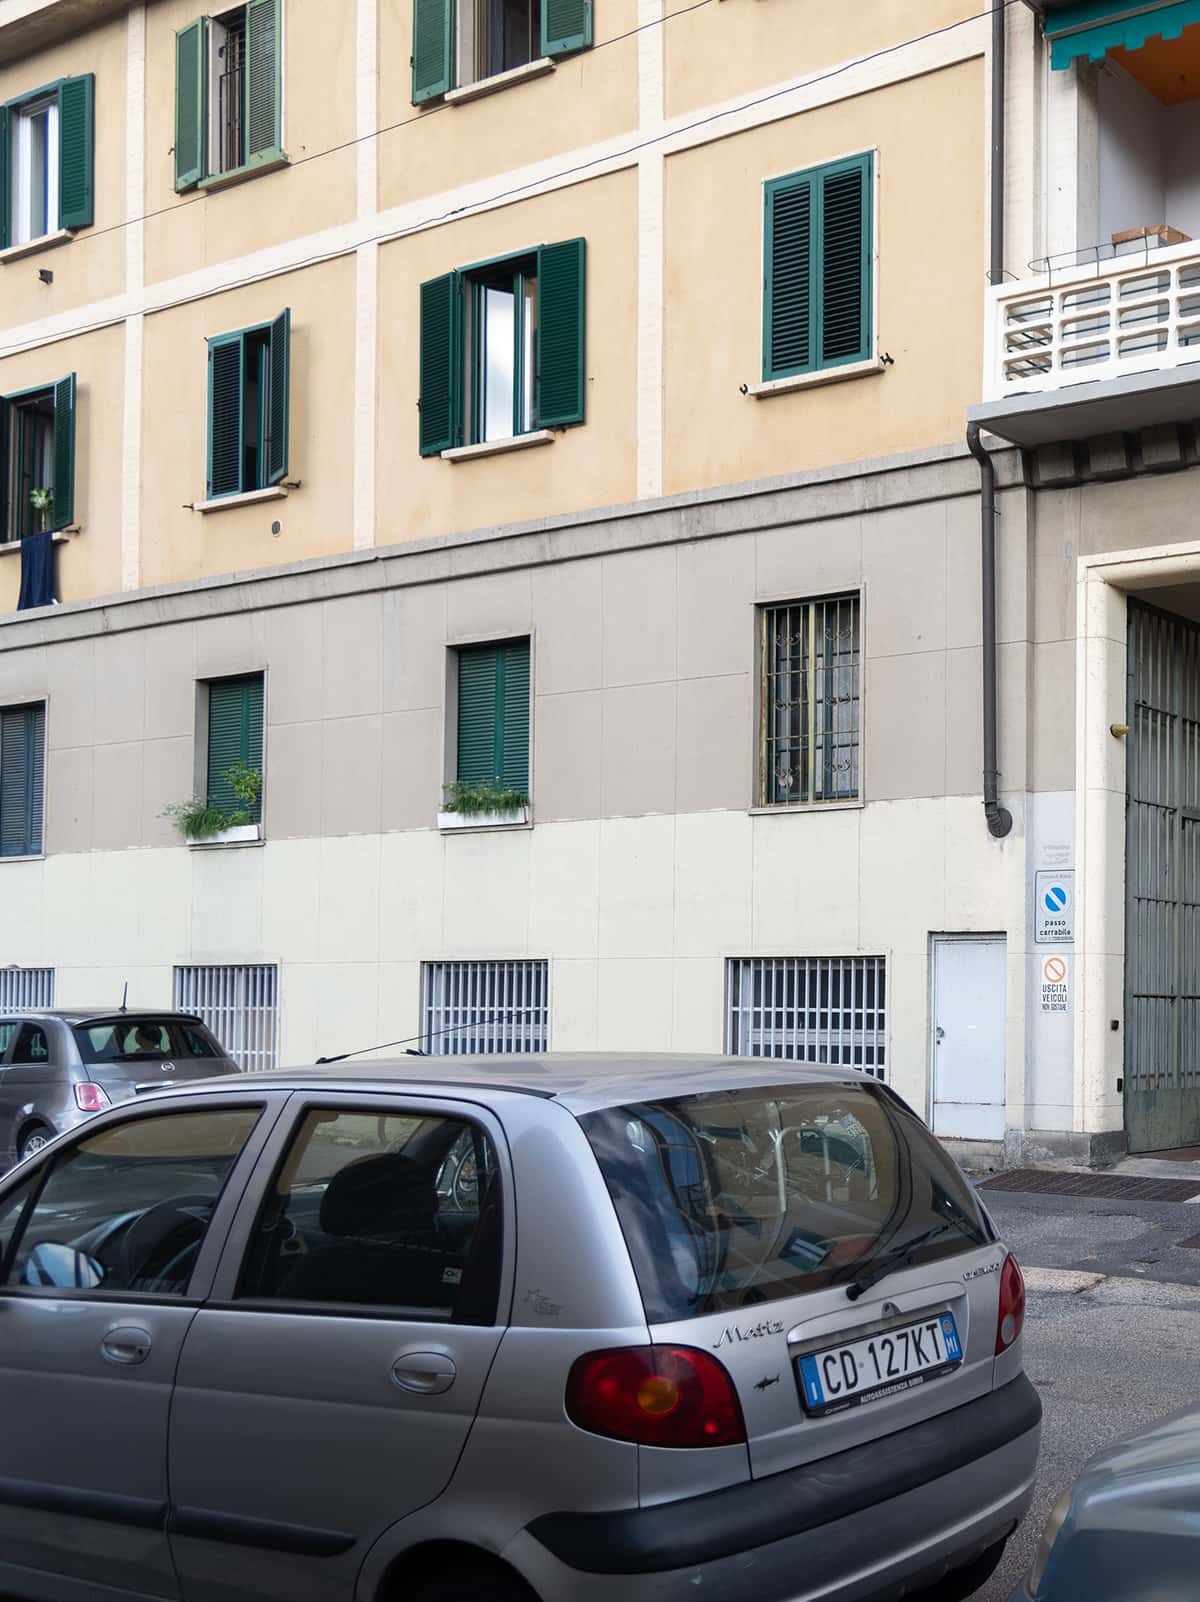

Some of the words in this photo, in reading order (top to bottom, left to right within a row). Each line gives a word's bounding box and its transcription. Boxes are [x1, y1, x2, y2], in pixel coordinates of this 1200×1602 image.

[1042, 983, 1067, 993] USCITA
[1042, 993, 1068, 1003] VEICOLI
[713, 1320, 784, 1349] Matiz
[811, 1382, 819, 1401] I
[822, 1349, 859, 1395] CD
[867, 1322, 942, 1381] 127KT
[945, 1337, 959, 1354] MI
